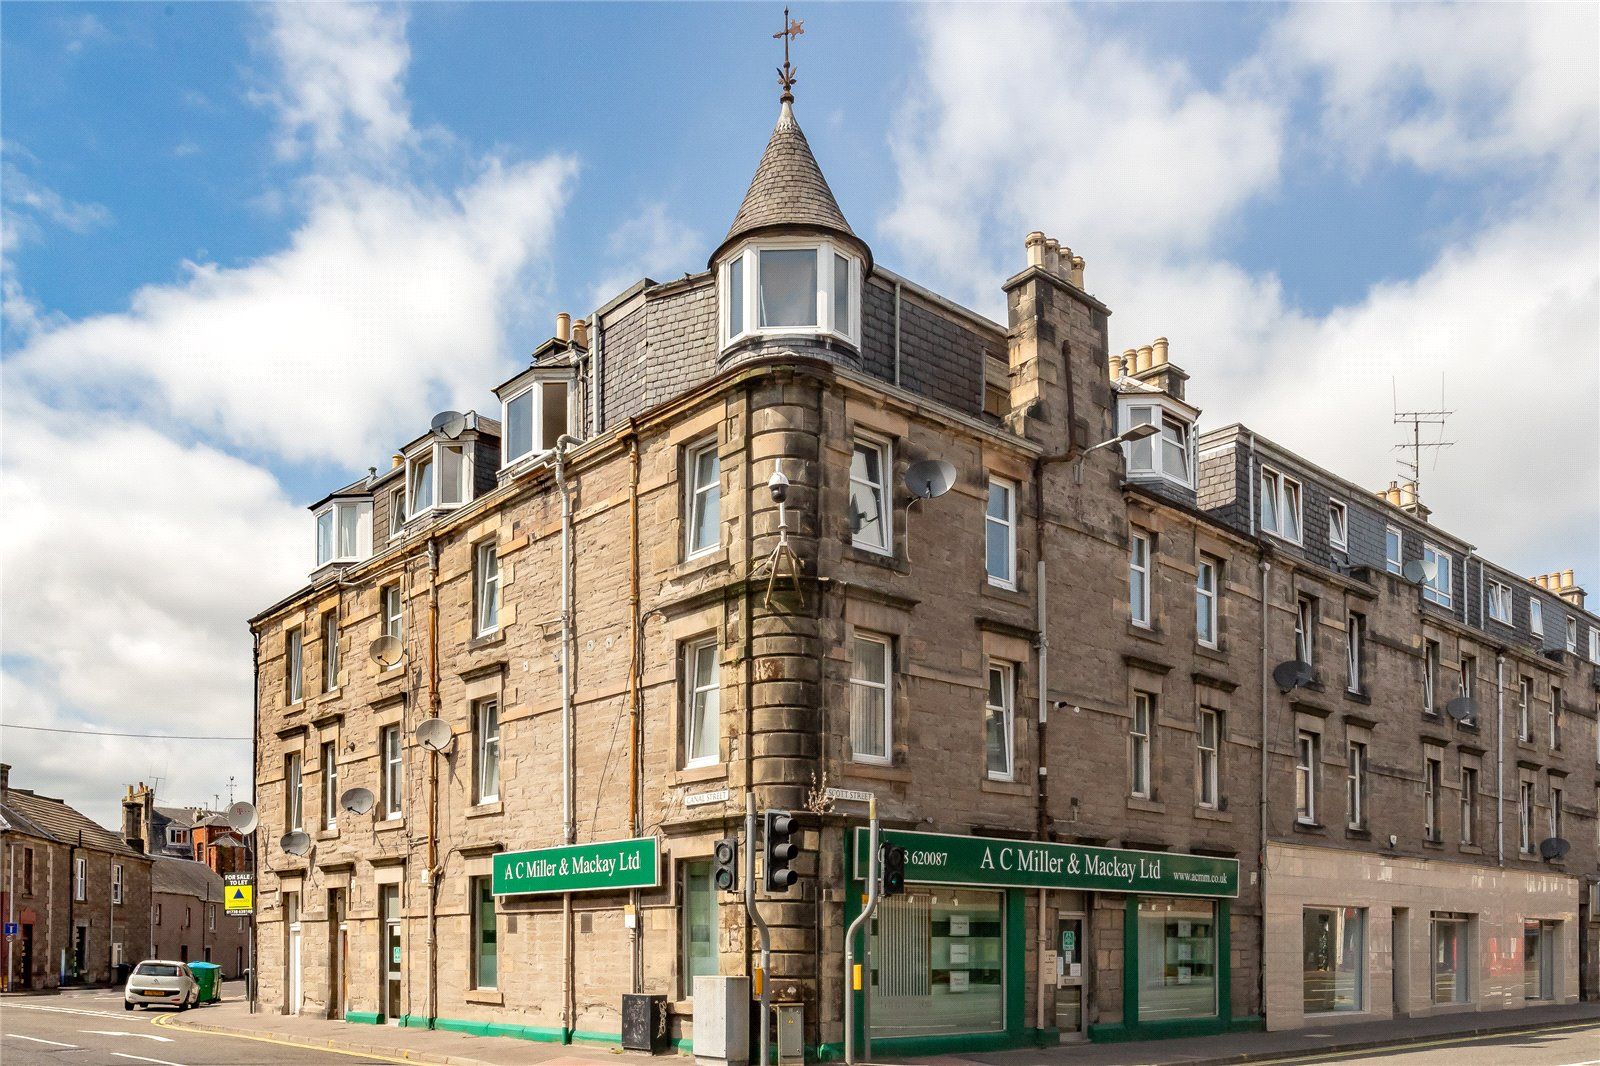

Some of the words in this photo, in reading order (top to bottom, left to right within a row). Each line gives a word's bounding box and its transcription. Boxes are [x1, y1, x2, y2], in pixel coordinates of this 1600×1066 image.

[686, 794, 706, 804] CANAL
[706, 791, 726, 801] STREET
[828, 788, 848, 799] SCOTT
[850, 791, 872, 801] STREET
[504, 863, 513, 880] A
[515, 861, 524, 879] C
[526, 859, 556, 878] Miller
[558, 857, 569, 876] &
[572, 854, 616, 877] Mackay
[619, 851, 640, 871] Ltd
[911, 851, 948, 866] 620087
[980, 846, 995, 870] A
[1000, 847, 1013, 871] C
[1017, 848, 1064, 874] Miller
[1067, 852, 1081, 875] &
[1084, 853, 1136, 884] Mackay
[1139, 858, 1161, 880] Ltd
[1173, 871, 1228, 884] www.acmm.co.uk
